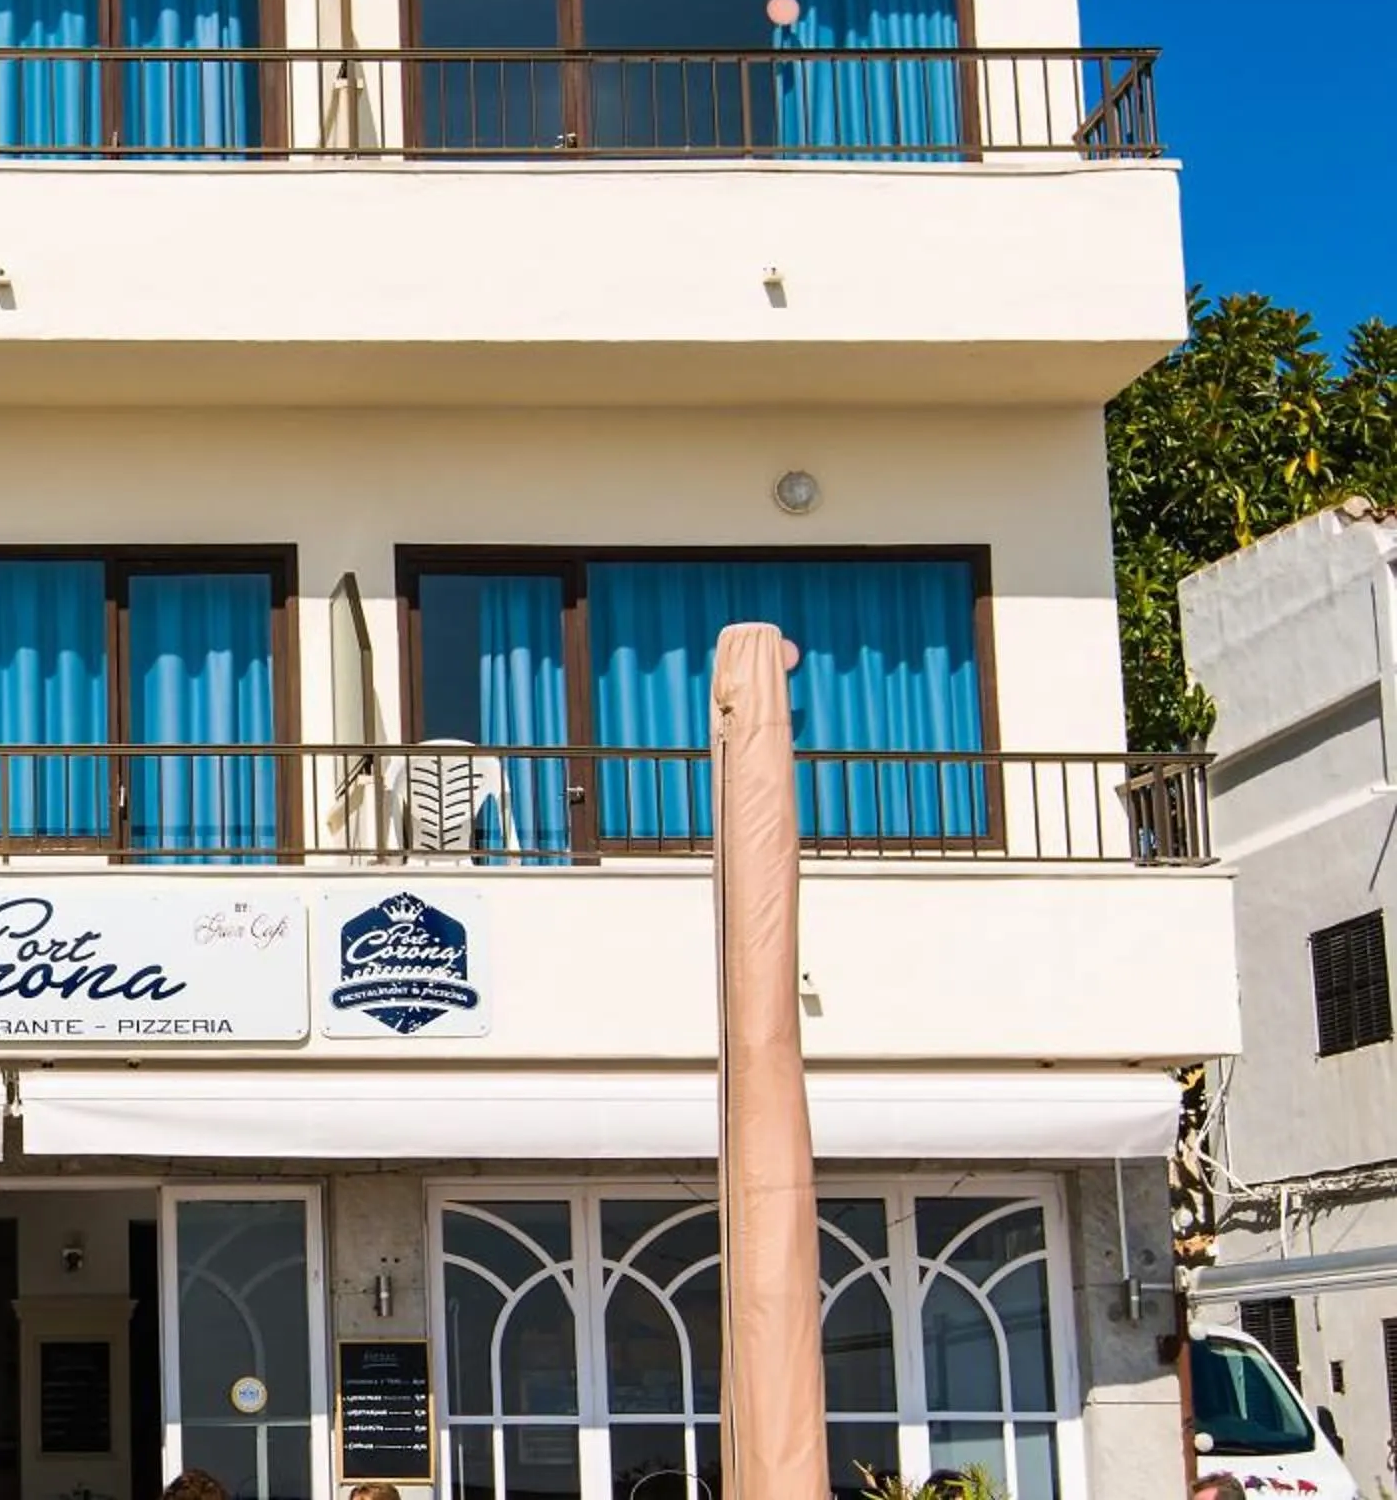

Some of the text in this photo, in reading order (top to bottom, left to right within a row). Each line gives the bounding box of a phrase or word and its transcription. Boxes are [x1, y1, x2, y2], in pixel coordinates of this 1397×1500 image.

[387, 923, 431, 945] Port
[346, 930, 463, 966] Corona
[117, 1019, 234, 1035] PIZZERIA
